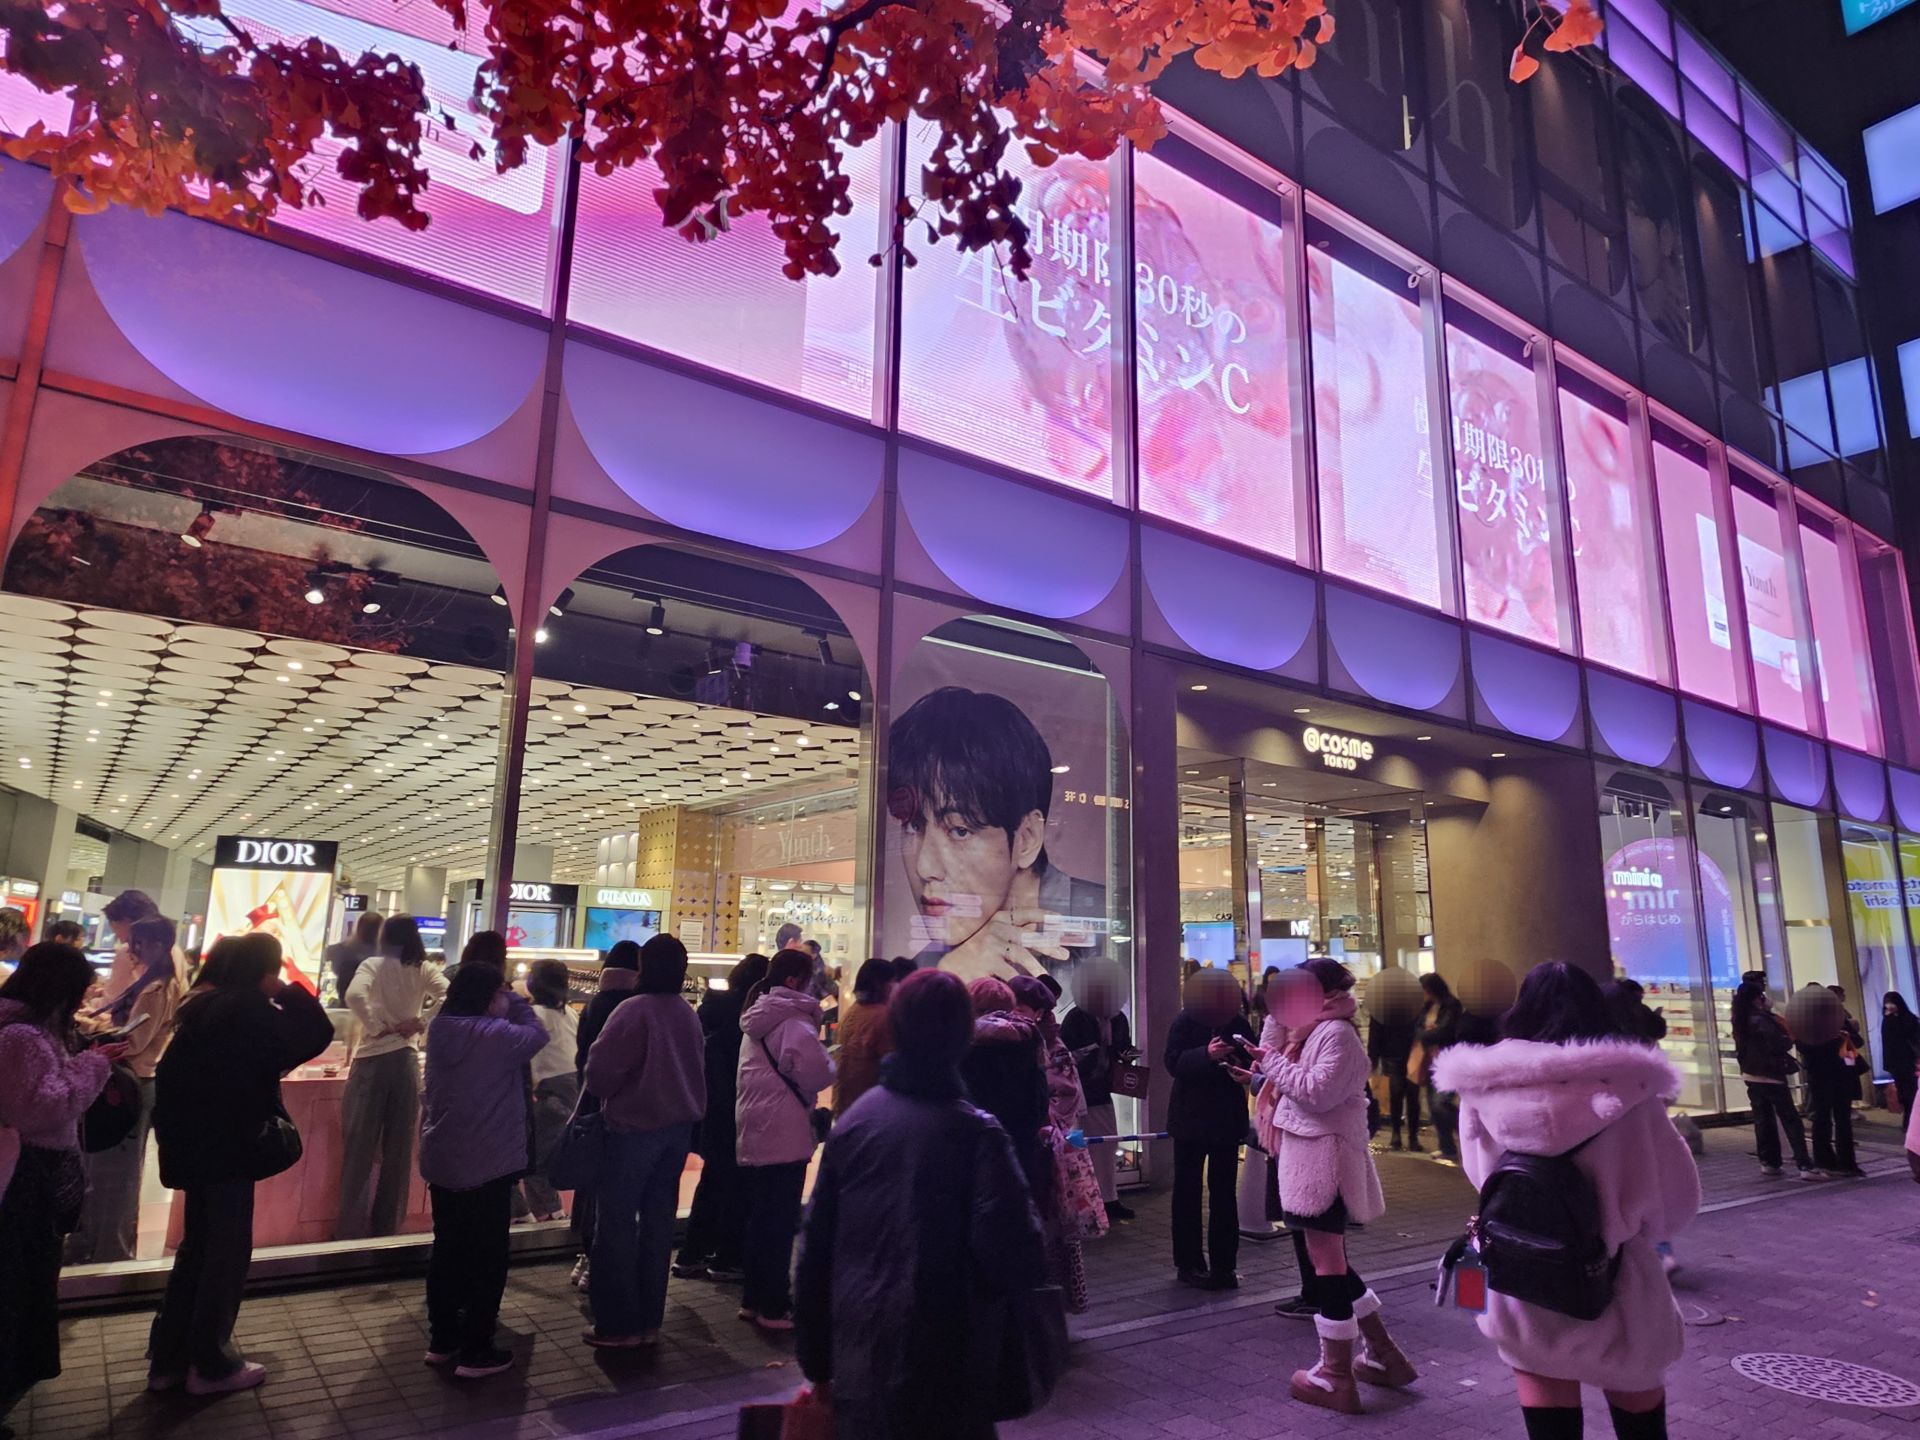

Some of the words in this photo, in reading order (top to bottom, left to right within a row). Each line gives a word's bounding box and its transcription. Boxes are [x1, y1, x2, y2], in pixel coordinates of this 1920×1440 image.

[1303, 727, 1374, 760] @cosme
[1323, 753, 1357, 771] TOKYO
[235, 840, 316, 866] DIOR
